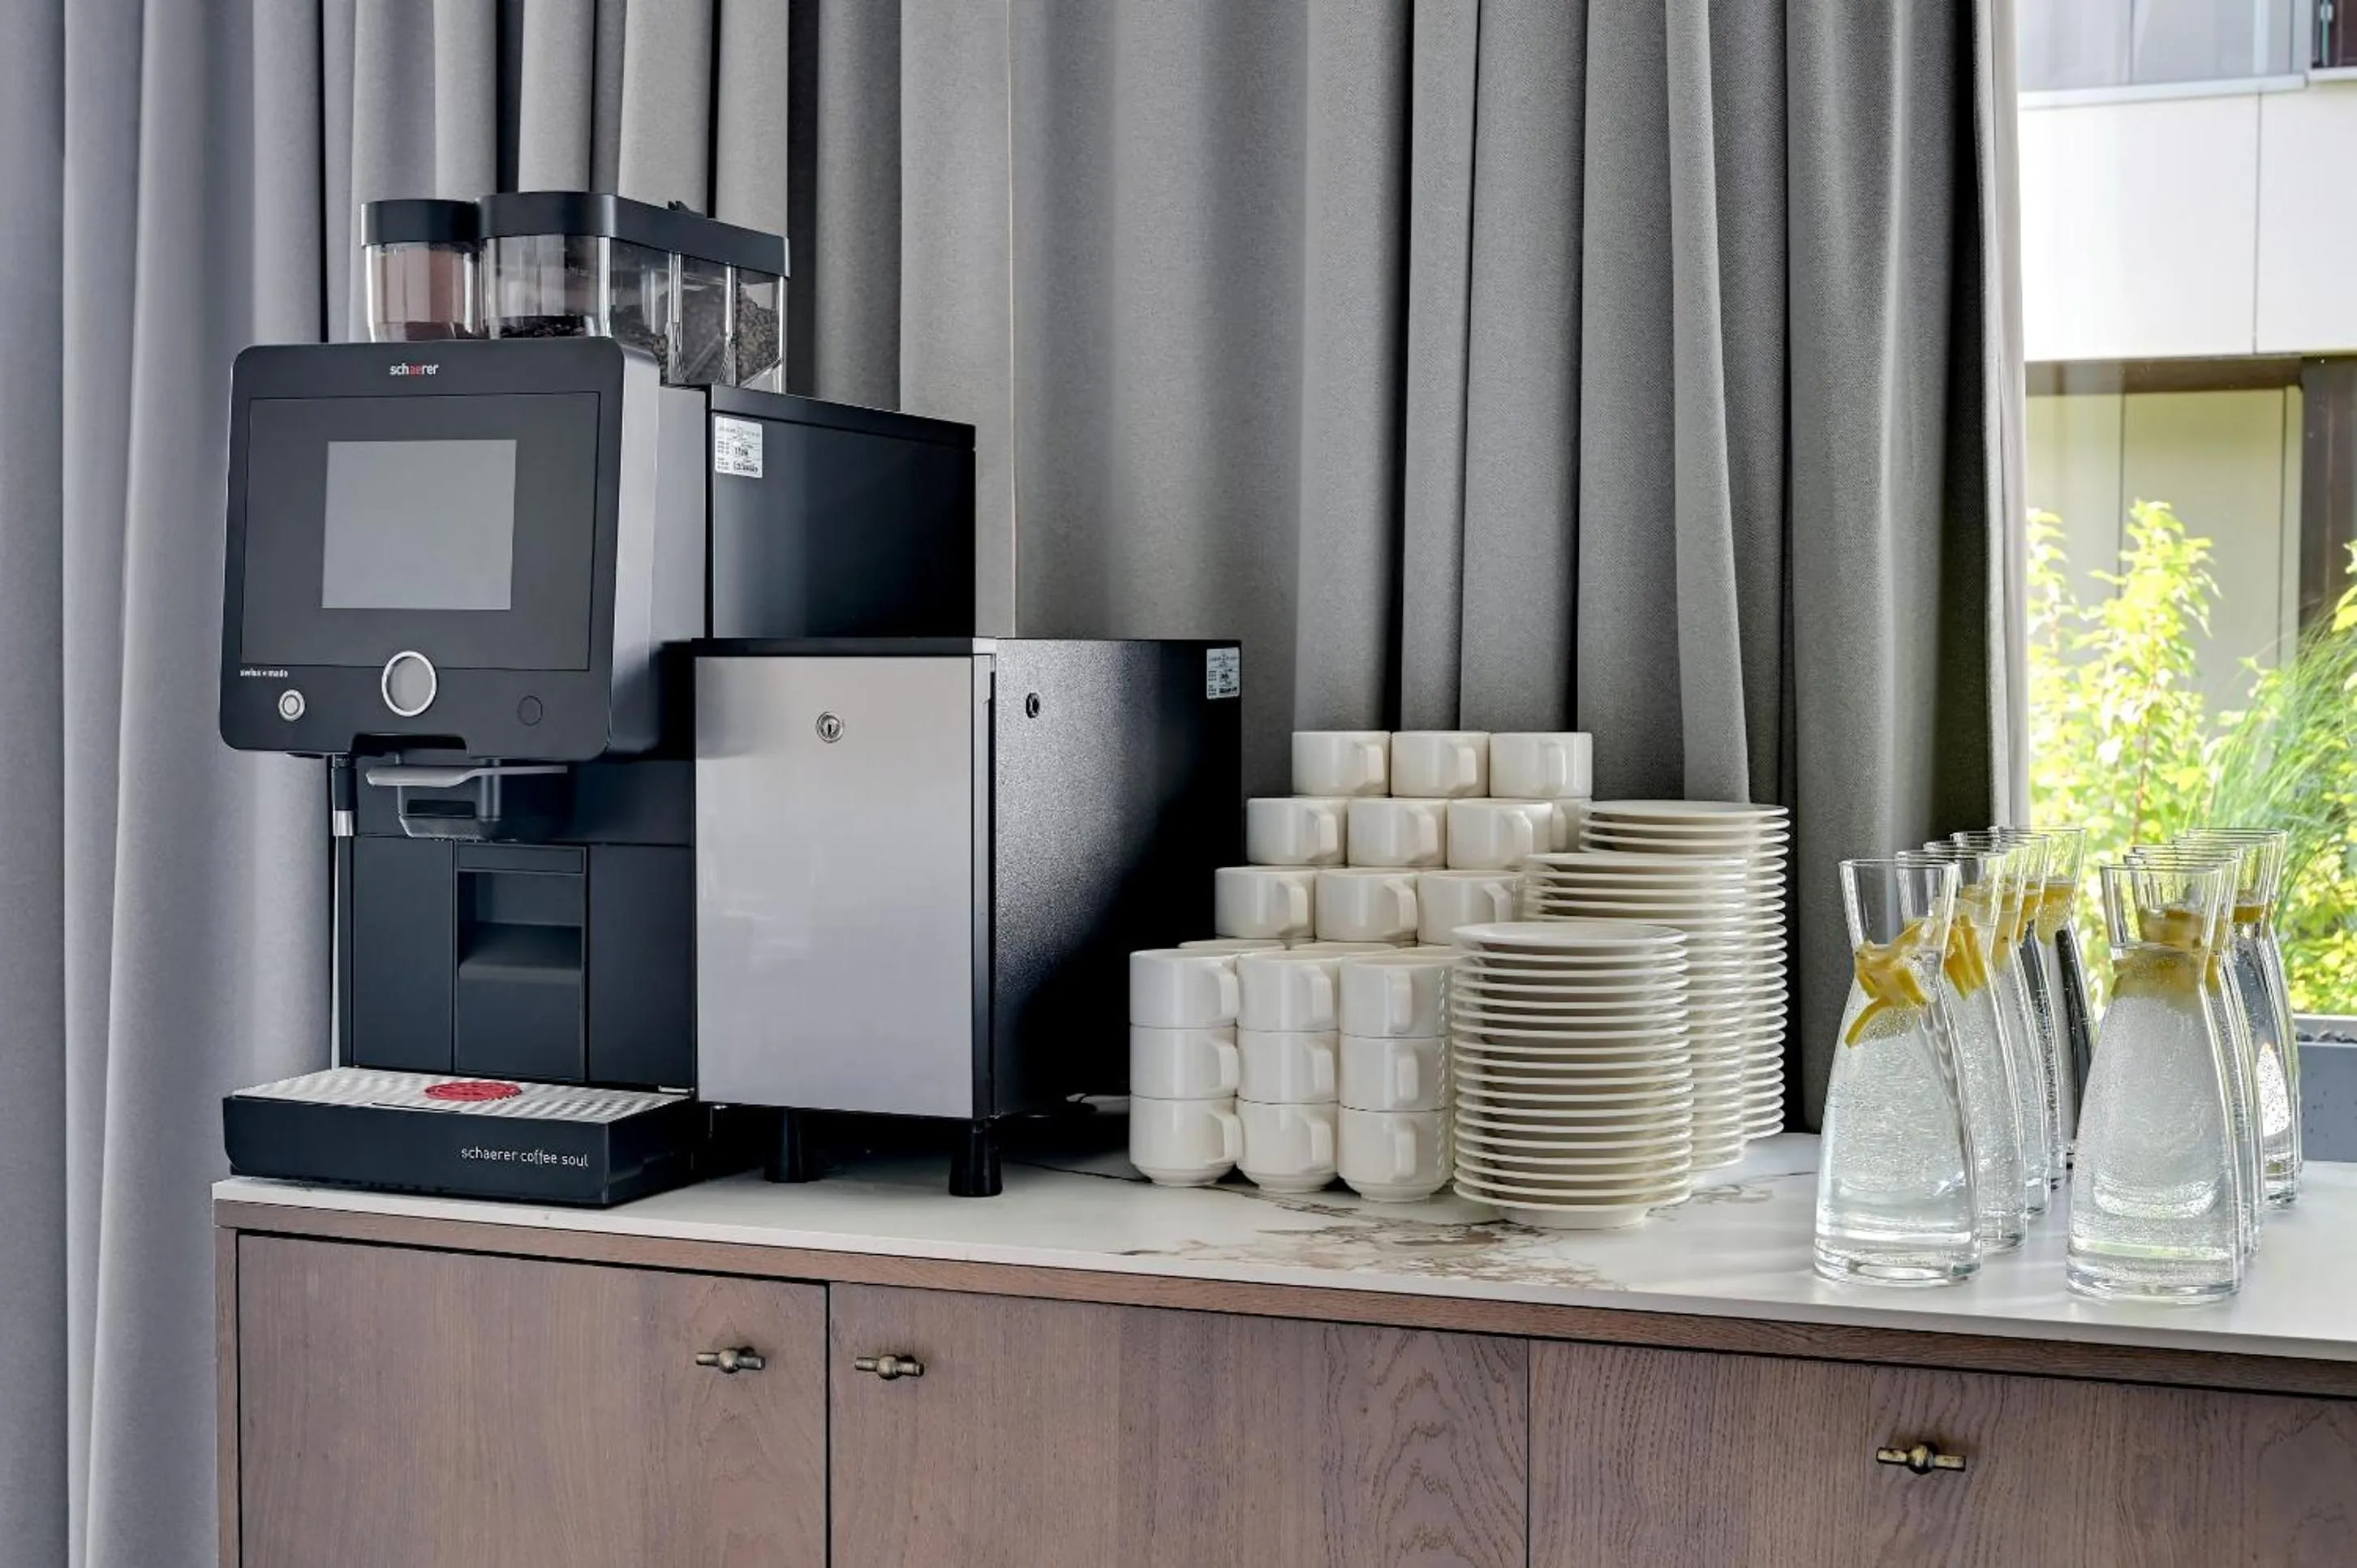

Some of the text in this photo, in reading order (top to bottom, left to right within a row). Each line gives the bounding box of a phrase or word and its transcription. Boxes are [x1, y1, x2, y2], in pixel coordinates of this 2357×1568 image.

[389, 363, 439, 375] schaerer
[461, 1146, 589, 1167] schaerer coffee soul
